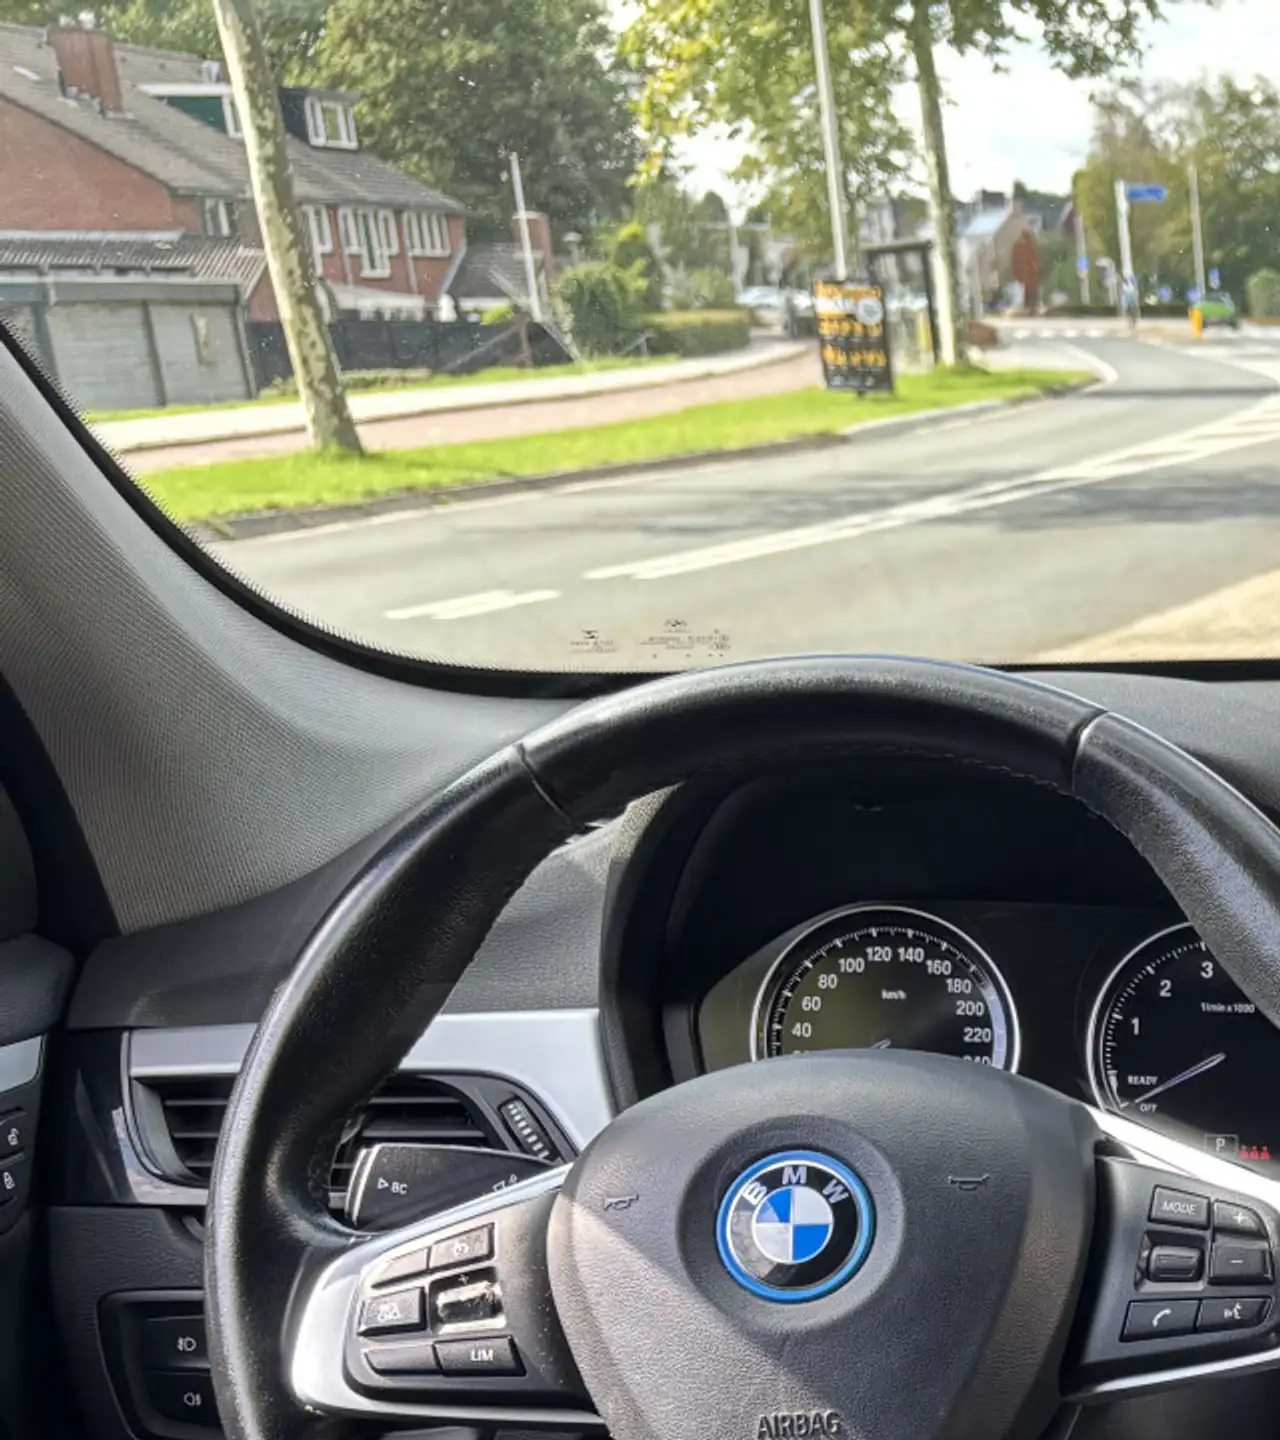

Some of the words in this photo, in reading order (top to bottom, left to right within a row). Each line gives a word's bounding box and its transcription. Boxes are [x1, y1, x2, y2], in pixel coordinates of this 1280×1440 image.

[866, 947, 892, 962] 120
[898, 947, 925, 963] 140
[838, 957, 865, 973] 100
[926, 960, 952, 975] 160
[1200, 961, 1214, 979] 3
[818, 974, 838, 989] 80
[946, 978, 972, 994] 180
[1159, 979, 1172, 998] 2
[881, 989, 907, 1000] km/h
[802, 996, 821, 1011] 60
[956, 1000, 984, 1016] 200
[791, 1022, 811, 1037] 40
[1131, 1017, 1140, 1036] 1
[963, 1027, 992, 1042] 220
[1127, 1075, 1159, 1086] READY
[1215, 1138, 1225, 1152] P
[391, 1181, 408, 1195] BC
[743, 1165, 848, 1206] BMW
[1162, 1200, 1197, 1217] MODE
[471, 1349, 494, 1362] LIM
[756, 1411, 843, 1440] AIRBAG
